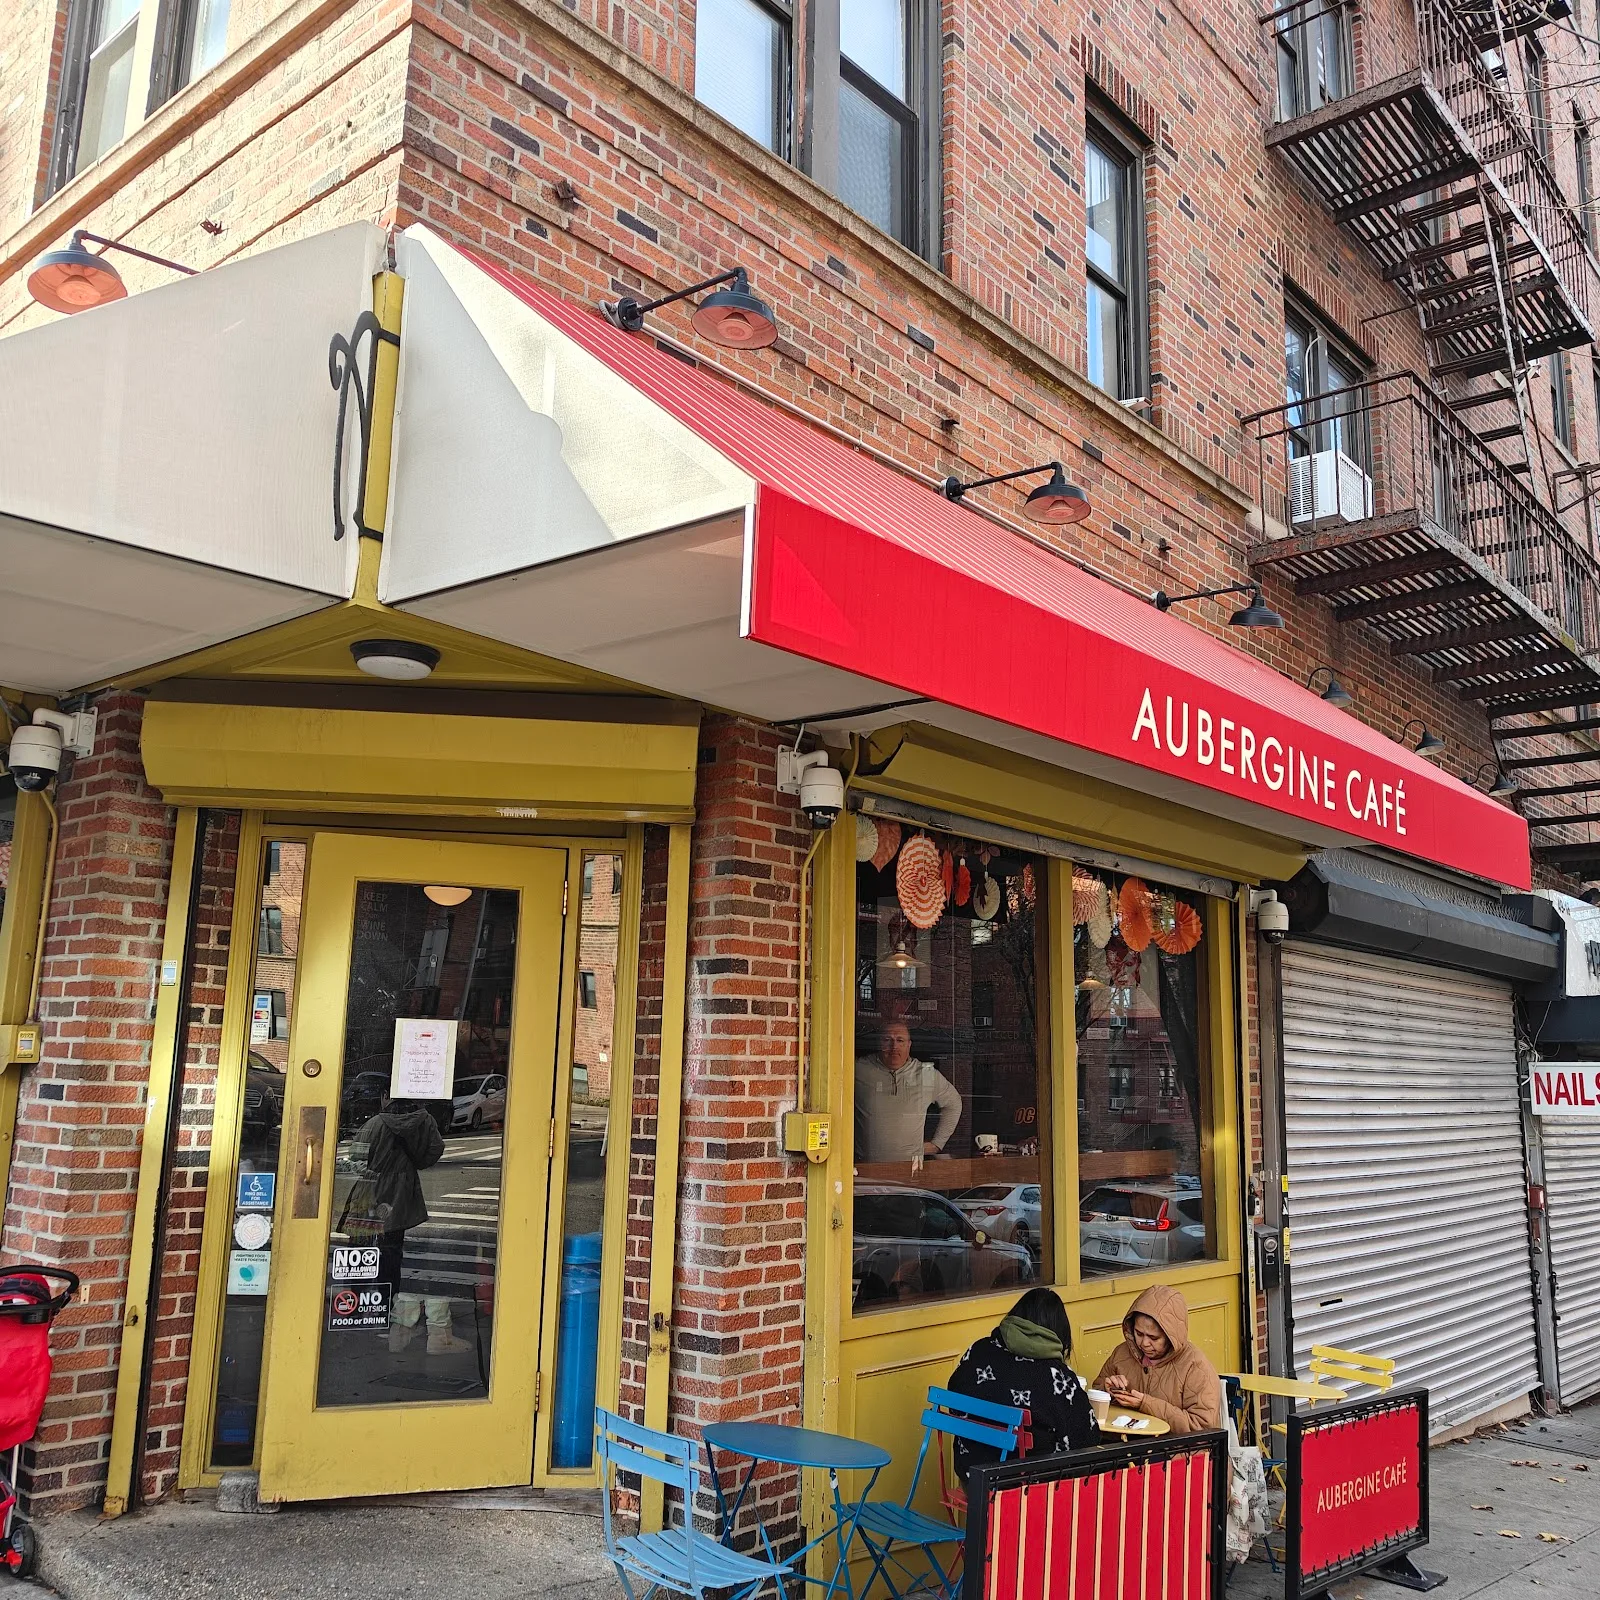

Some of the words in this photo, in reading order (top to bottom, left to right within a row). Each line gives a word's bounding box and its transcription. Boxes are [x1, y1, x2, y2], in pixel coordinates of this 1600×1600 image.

[1131, 687, 1336, 810] AUBERGINE
[1345, 769, 1407, 835] CAFÉ
[335, 1250, 361, 1267] NO
[350, 1265, 377, 1273] ALLOWED
[359, 1291, 383, 1306] NO
[358, 1304, 387, 1313] OUTSIDE
[332, 1318, 354, 1326] FOOD
[363, 1316, 386, 1325] DRINK
[1316, 1470, 1381, 1514] AUBERGINE
[1383, 1456, 1407, 1489] CAFÉ
